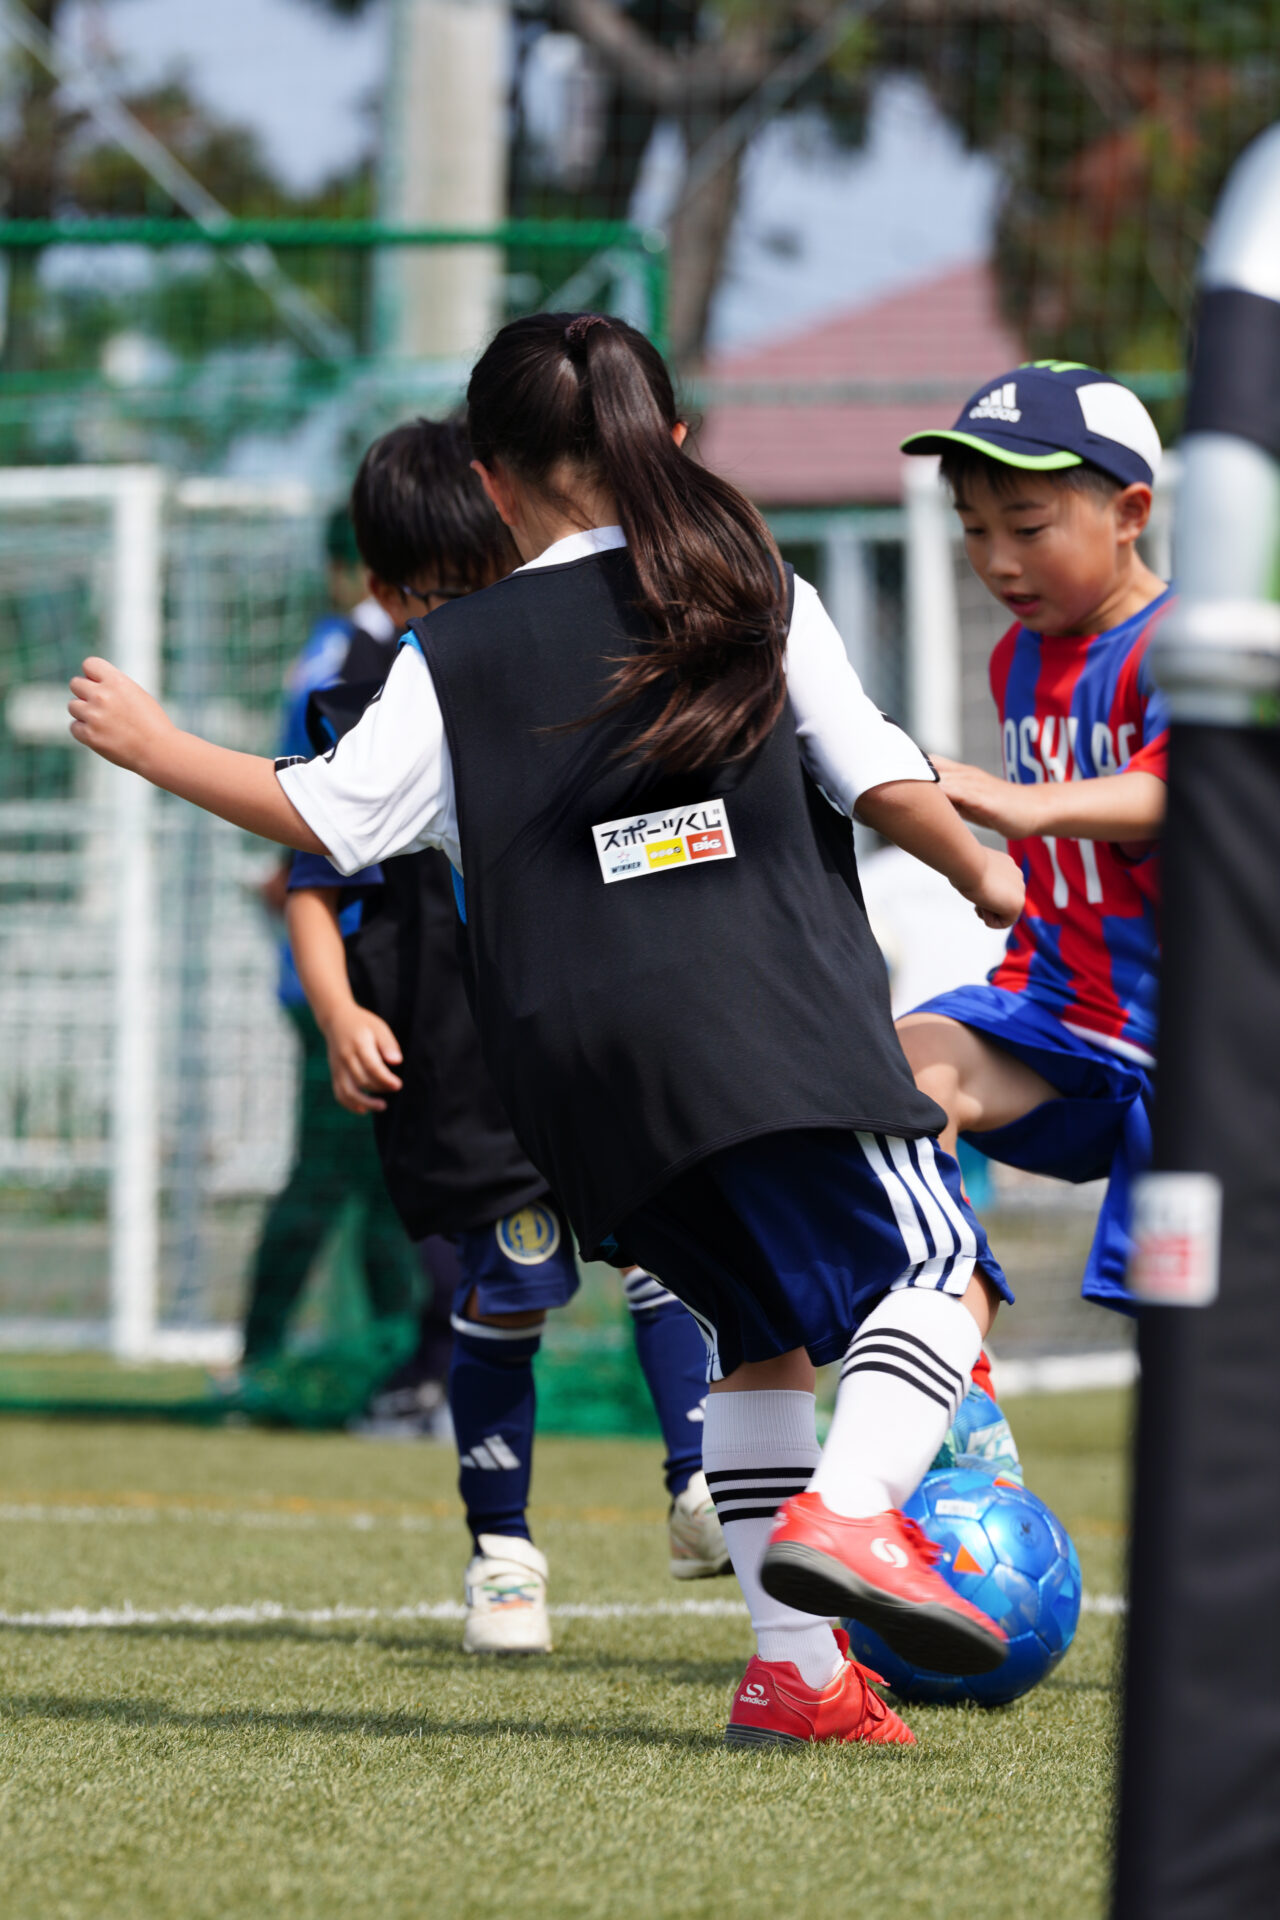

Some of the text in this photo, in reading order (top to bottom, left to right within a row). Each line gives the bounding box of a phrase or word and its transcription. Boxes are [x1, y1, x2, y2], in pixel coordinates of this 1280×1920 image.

[601, 808, 721, 851] スポーツくじ
